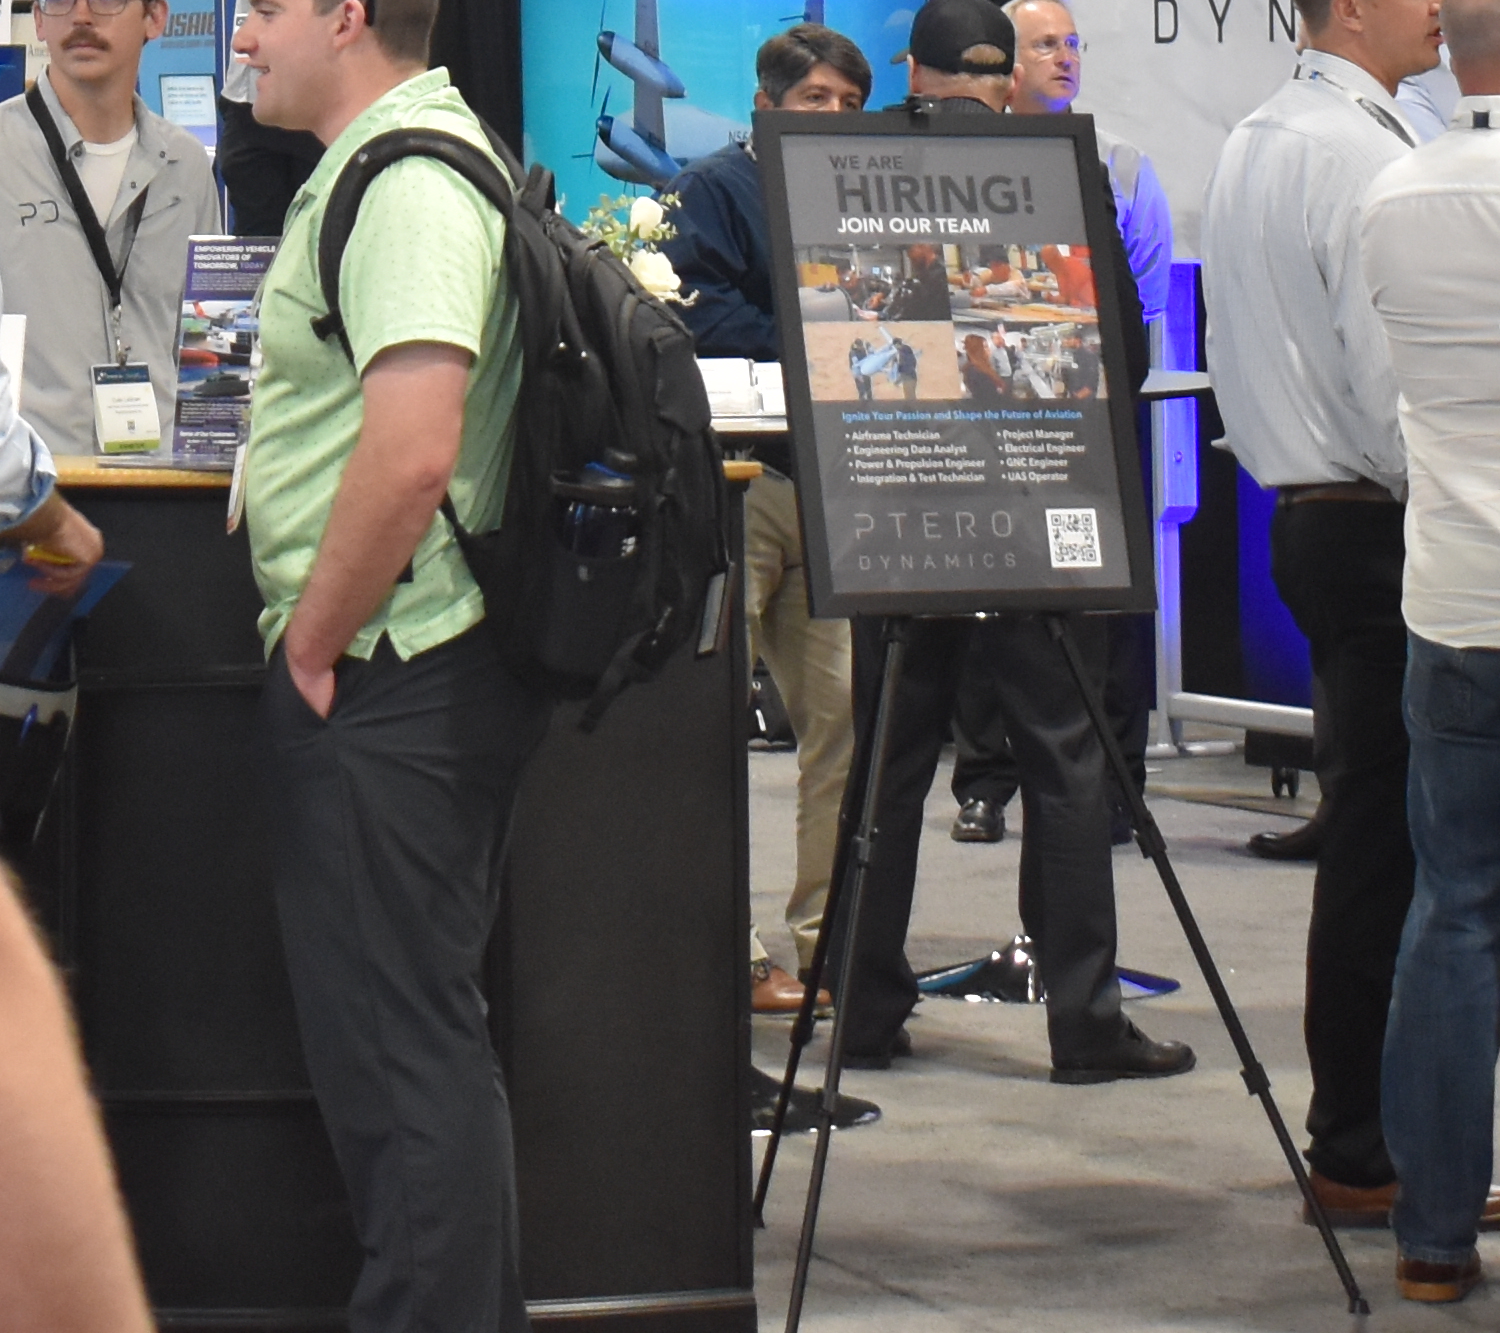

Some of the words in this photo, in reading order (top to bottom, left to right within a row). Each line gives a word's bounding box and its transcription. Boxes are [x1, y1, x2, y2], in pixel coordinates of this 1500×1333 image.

[829, 154, 861, 170] WE
[866, 155, 903, 171] ARE
[834, 174, 1036, 215] HIRING!
[836, 217, 884, 234] JOIN
[889, 217, 932, 234] OUR
[934, 217, 991, 234] TEAM
[841, 410, 871, 423] Ignite
[871, 410, 894, 421] Your
[895, 410, 933, 421] Passion
[933, 410, 952, 421] and
[952, 410, 983, 423] Shape
[984, 410, 1000, 420] the
[1001, 410, 1032, 420] Future
[1032, 410, 1043, 420] of
[1044, 410, 1083, 420] Aviation
[851, 430, 892, 441] Airframe
[893, 430, 941, 441] Technician
[1002, 429, 1034, 441] Project
[1034, 429, 1075, 441] Manager
[853, 444, 910, 457] Engineering
[910, 444, 932, 455] Data
[932, 444, 968, 457] Analyst
[1004, 443, 1046, 454] Electrical
[1046, 443, 1086, 456] Engineer
[854, 459, 885, 469] Power
[944, 458, 986, 471] Engineer
[1028, 457, 1068, 470] Engineer
[856, 472, 908, 485] Integration
[917, 473, 939, 483] Test
[939, 472, 985, 483] Technician
[1007, 471, 1027, 482] UAS
[1028, 471, 1069, 484] Operator
[853, 509, 1013, 540] PTERO
[858, 552, 1017, 571] DYNAMICS
